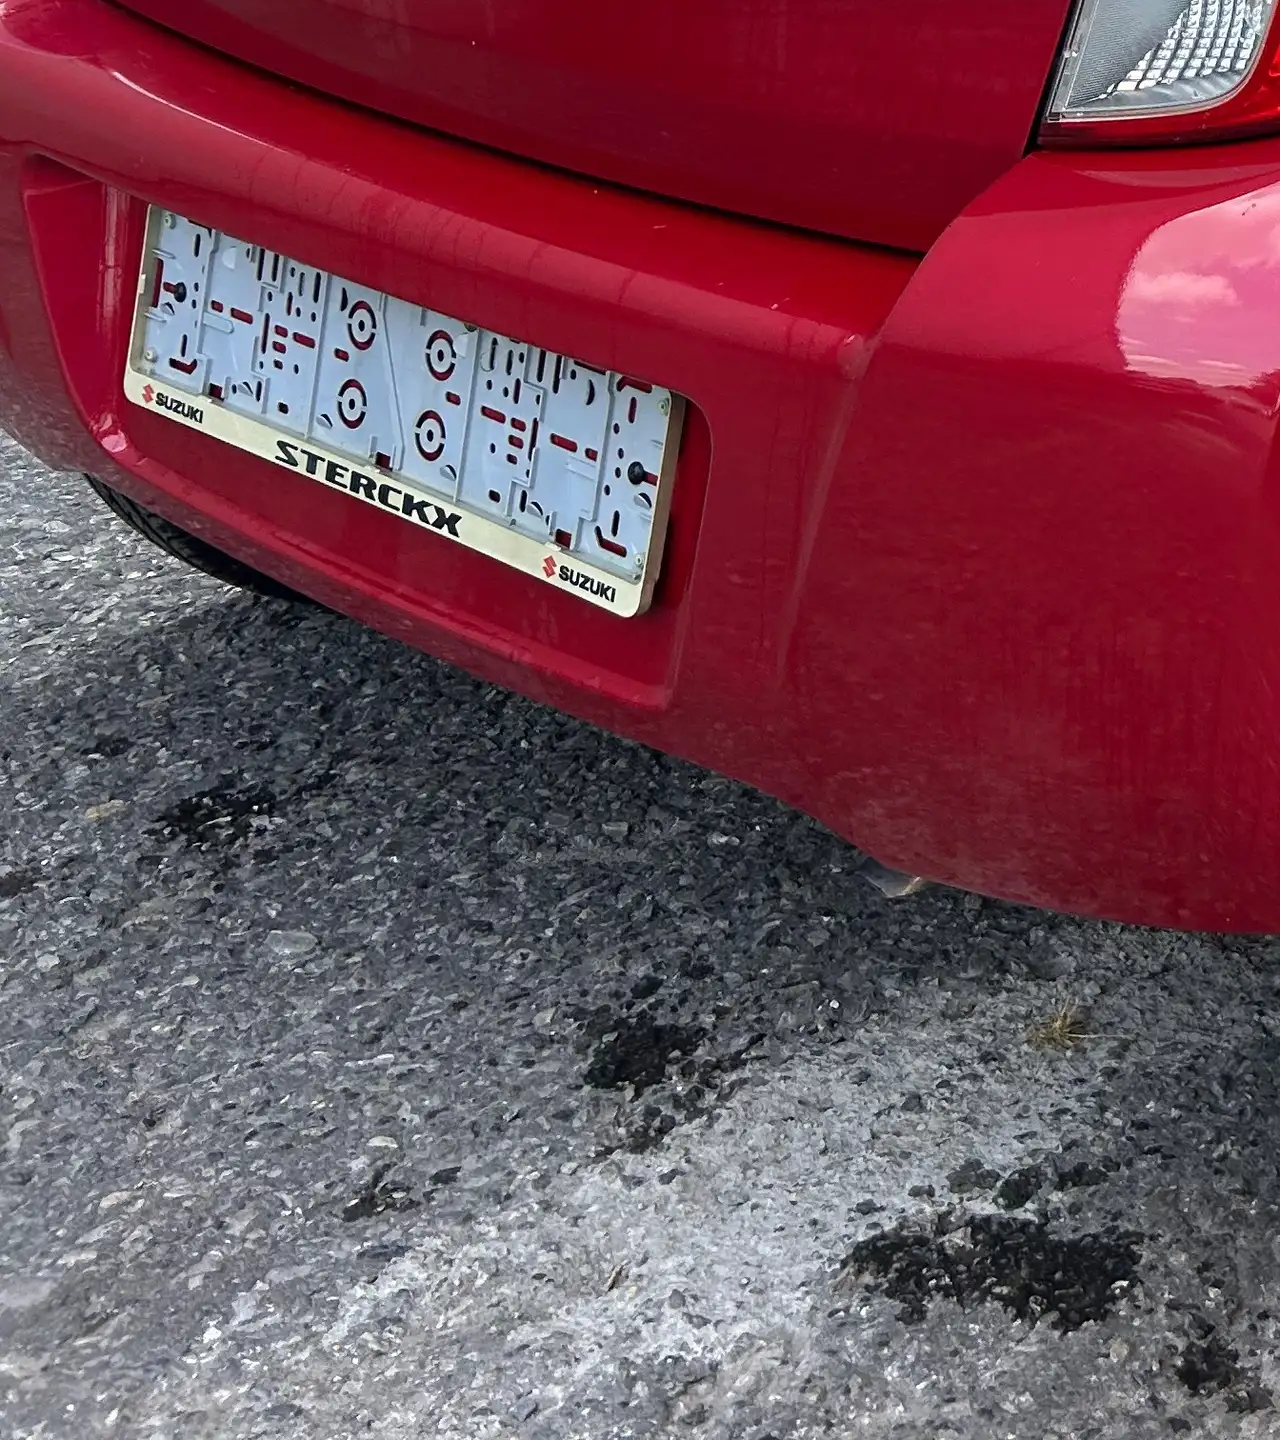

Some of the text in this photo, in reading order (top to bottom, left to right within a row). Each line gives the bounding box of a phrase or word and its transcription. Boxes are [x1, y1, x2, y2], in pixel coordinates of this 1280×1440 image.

[155, 392, 204, 424] SUZUKI
[275, 440, 463, 538] STERCKX
[558, 564, 617, 603] SUZUKI
